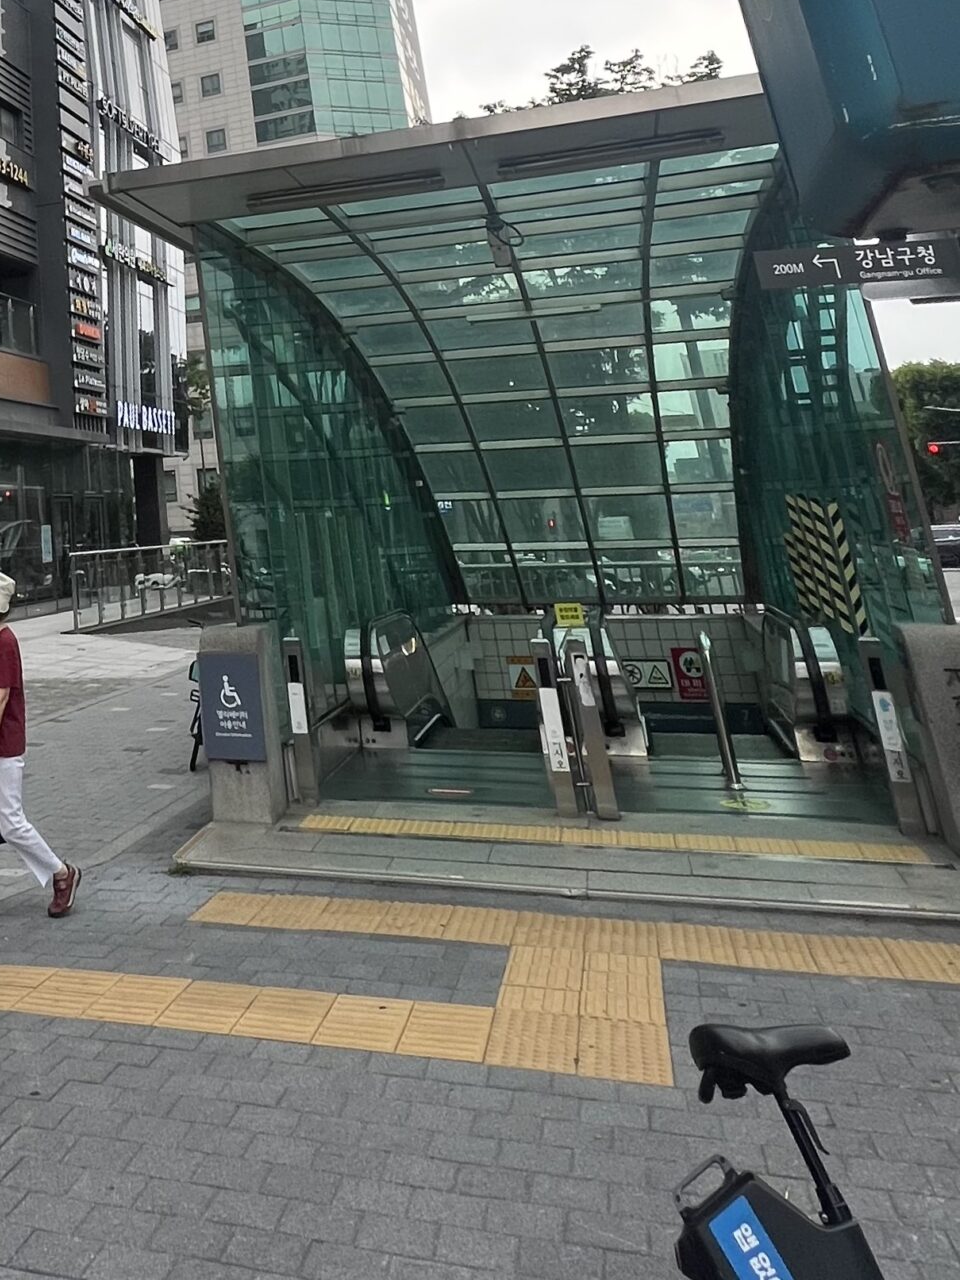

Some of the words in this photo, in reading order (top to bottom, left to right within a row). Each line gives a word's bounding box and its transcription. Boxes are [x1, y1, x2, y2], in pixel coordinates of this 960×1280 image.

[854, 244, 937, 270] 강남구청
[772, 262, 805, 276] 200M
[859, 269, 915, 280] Gangnam-gu
[916, 266, 943, 277] Office
[116, 400, 141, 431] PAUL
[141, 404, 176, 436] BASSETT
